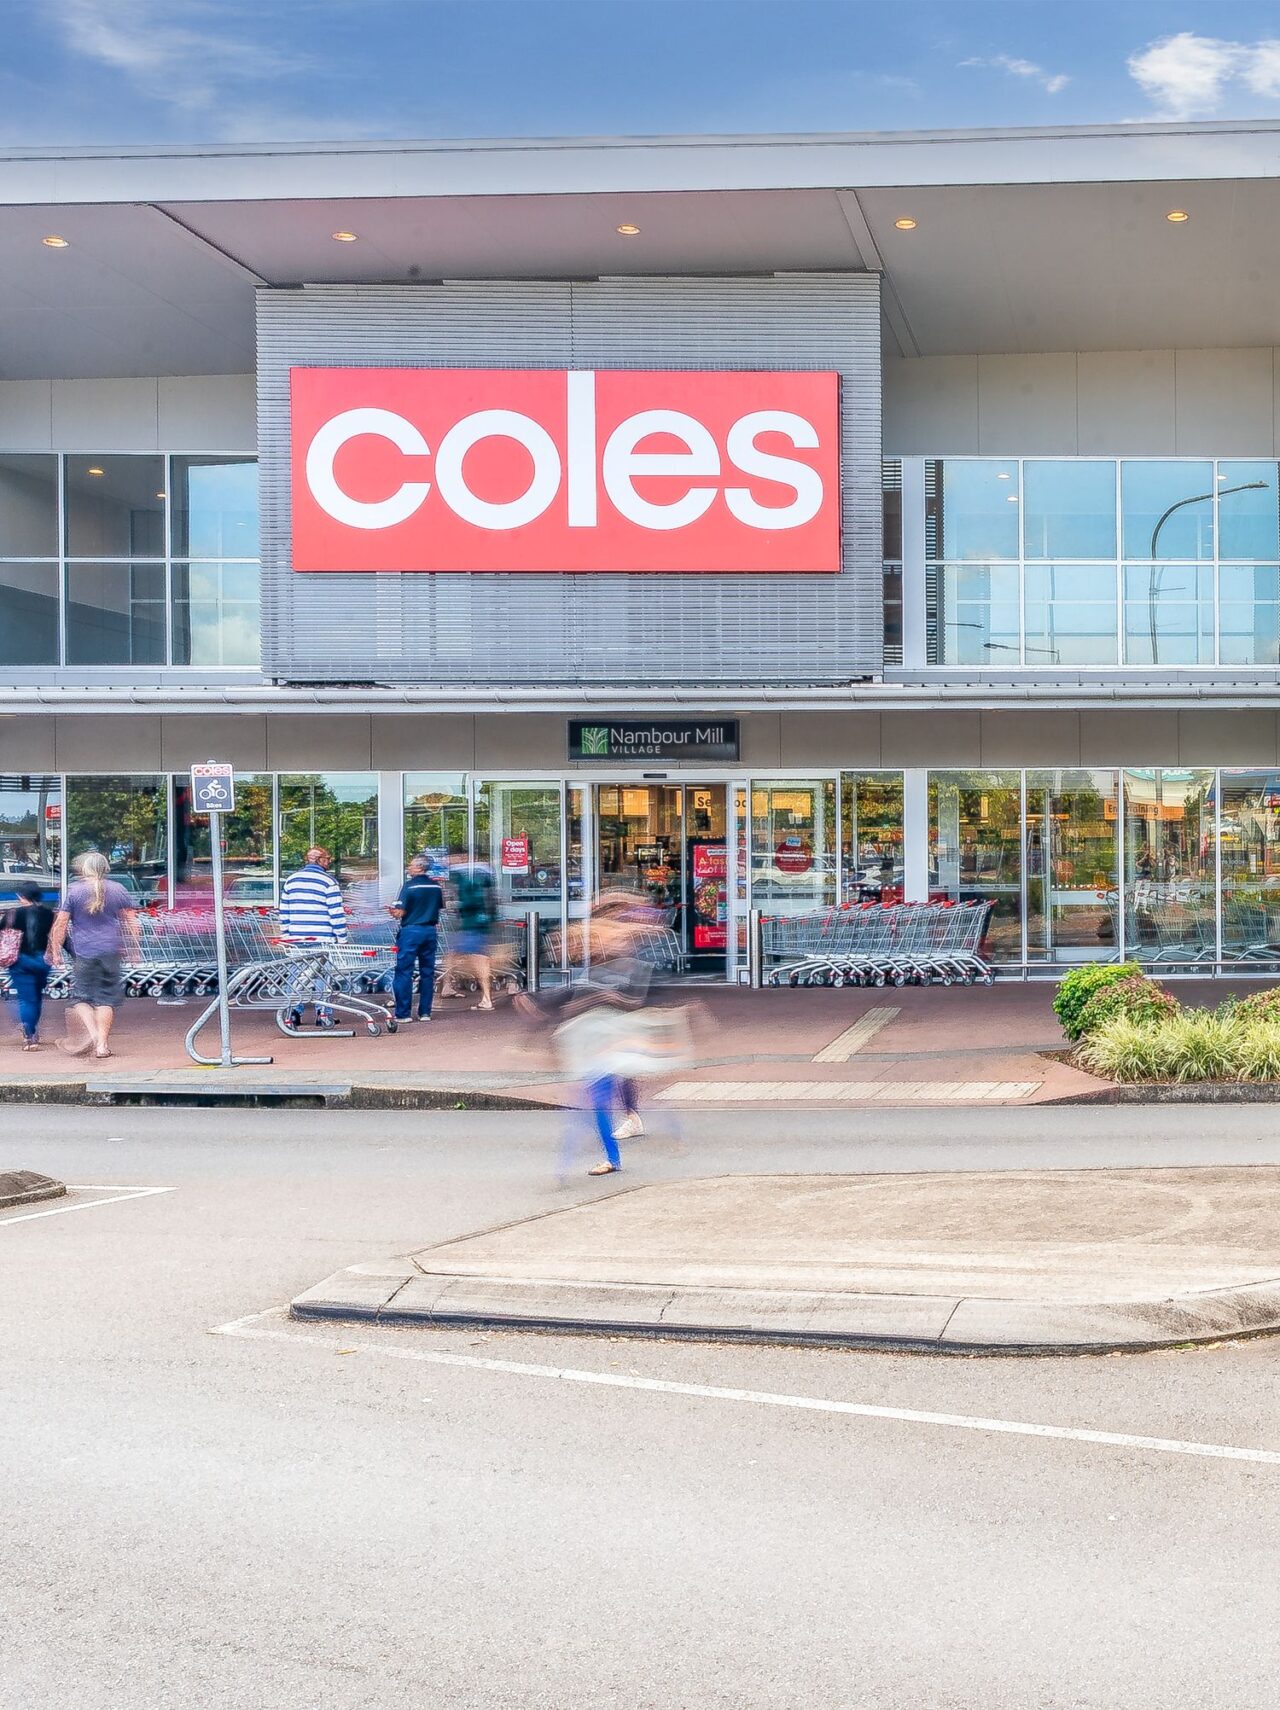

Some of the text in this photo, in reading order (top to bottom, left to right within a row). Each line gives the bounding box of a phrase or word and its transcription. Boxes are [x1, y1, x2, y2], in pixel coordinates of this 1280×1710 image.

[305, 370, 824, 530] coles
[611, 727, 724, 744] Nambour Mill
[611, 745, 662, 754] VILLAGE
[194, 766, 230, 776] coles
[505, 840, 524, 848] Open
[510, 846, 526, 854] days
